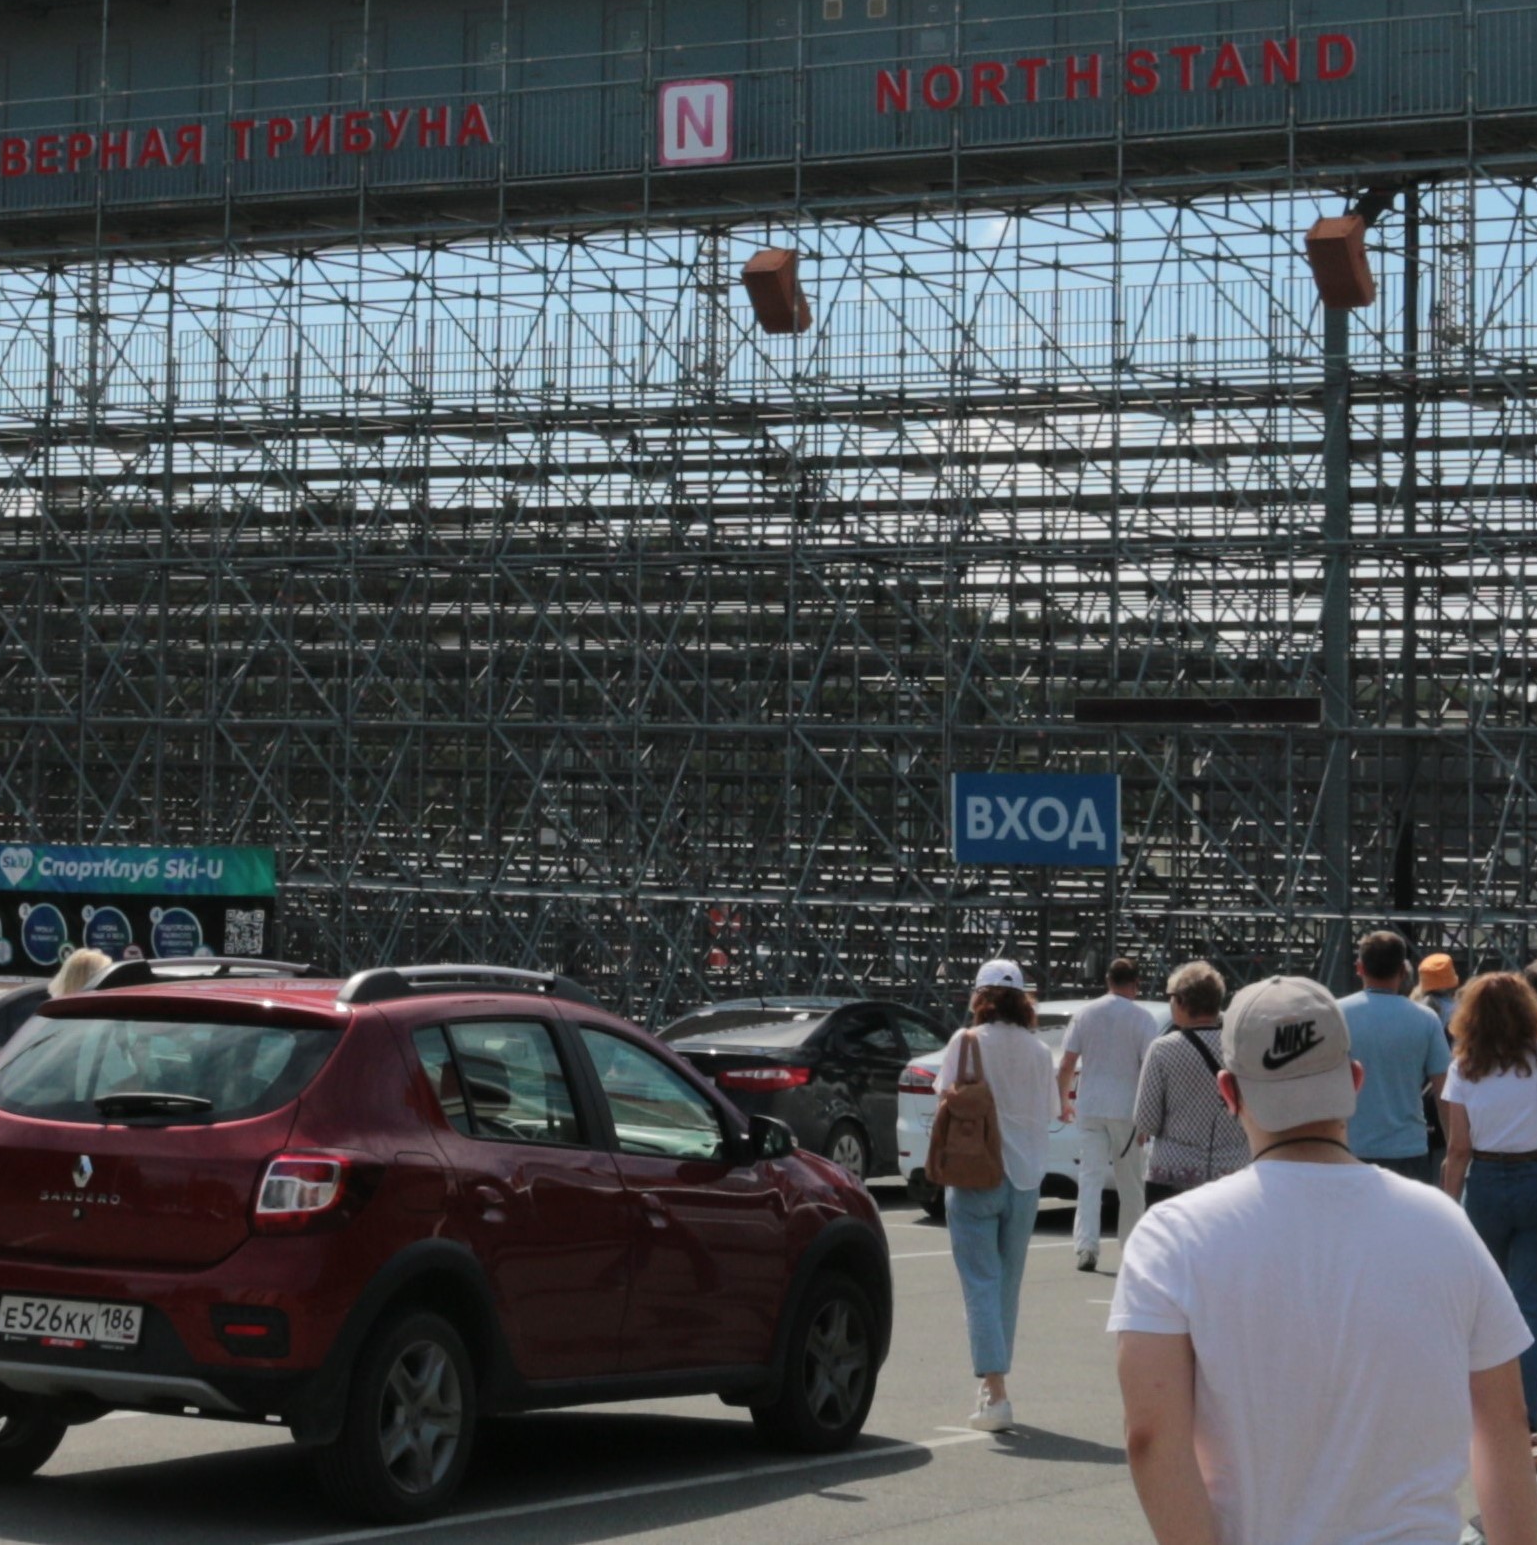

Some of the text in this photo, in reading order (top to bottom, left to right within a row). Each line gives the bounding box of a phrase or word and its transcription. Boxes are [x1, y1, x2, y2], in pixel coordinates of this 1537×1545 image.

[875, 33, 1357, 113] NORTH STAND
[228, 103, 491, 159] ТРИБУНА
[674, 93, 715, 151] N
[965, 795, 1107, 851] ВХОД
[37, 856, 224, 882] СпортКлуб Ski-U
[1272, 1019, 1317, 1056] NIKE
[38, 1189, 122, 1206] SANDERO
